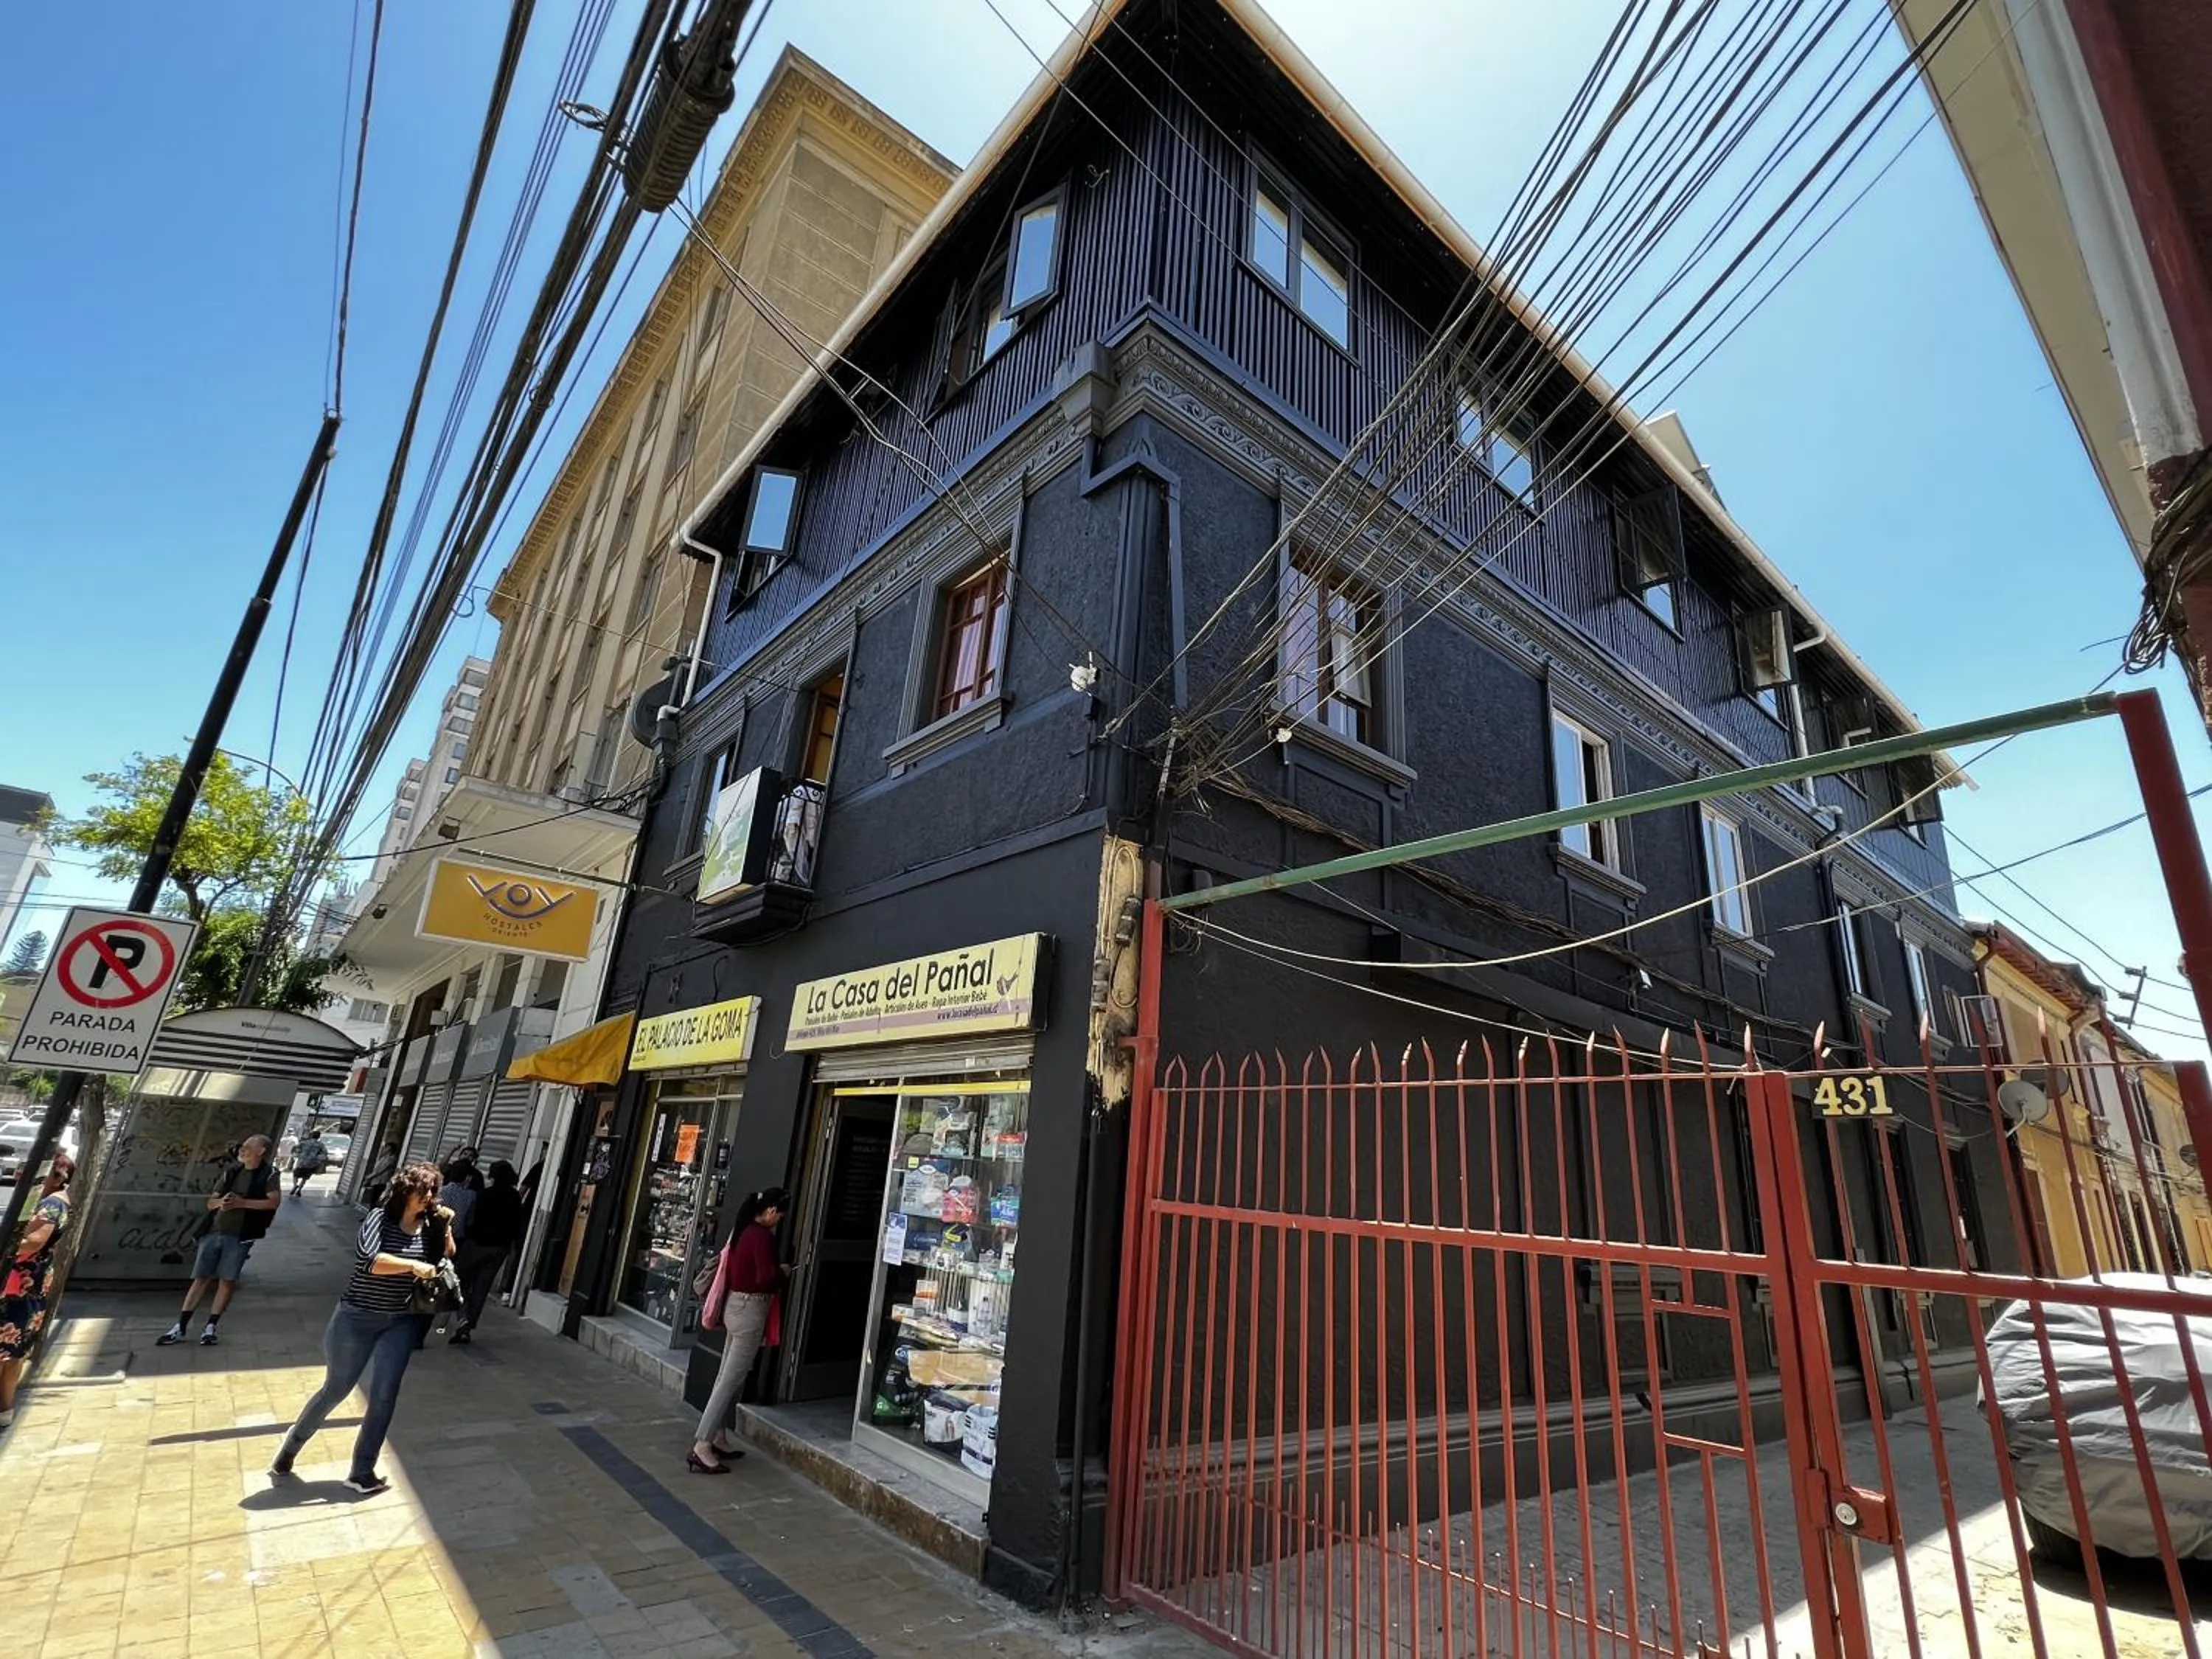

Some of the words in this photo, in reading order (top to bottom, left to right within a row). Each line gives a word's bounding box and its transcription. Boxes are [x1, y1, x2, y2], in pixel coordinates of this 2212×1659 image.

[483, 912, 543, 931] HOSTALES
[807, 986, 827, 1014] La
[831, 979, 879, 1010] Casa
[886, 963, 920, 999] del
[925, 947, 995, 995] Pañal
[49, 1011, 135, 1033] PARADA
[636, 1028, 647, 1054] EL
[648, 1019, 684, 1051] PALACIO
[682, 1017, 698, 1046] DE
[696, 1014, 712, 1044] LA
[711, 1008, 743, 1042] GOMA
[21, 1034, 139, 1060] PROHIBIDA
[1814, 1076, 1893, 1116] 431
